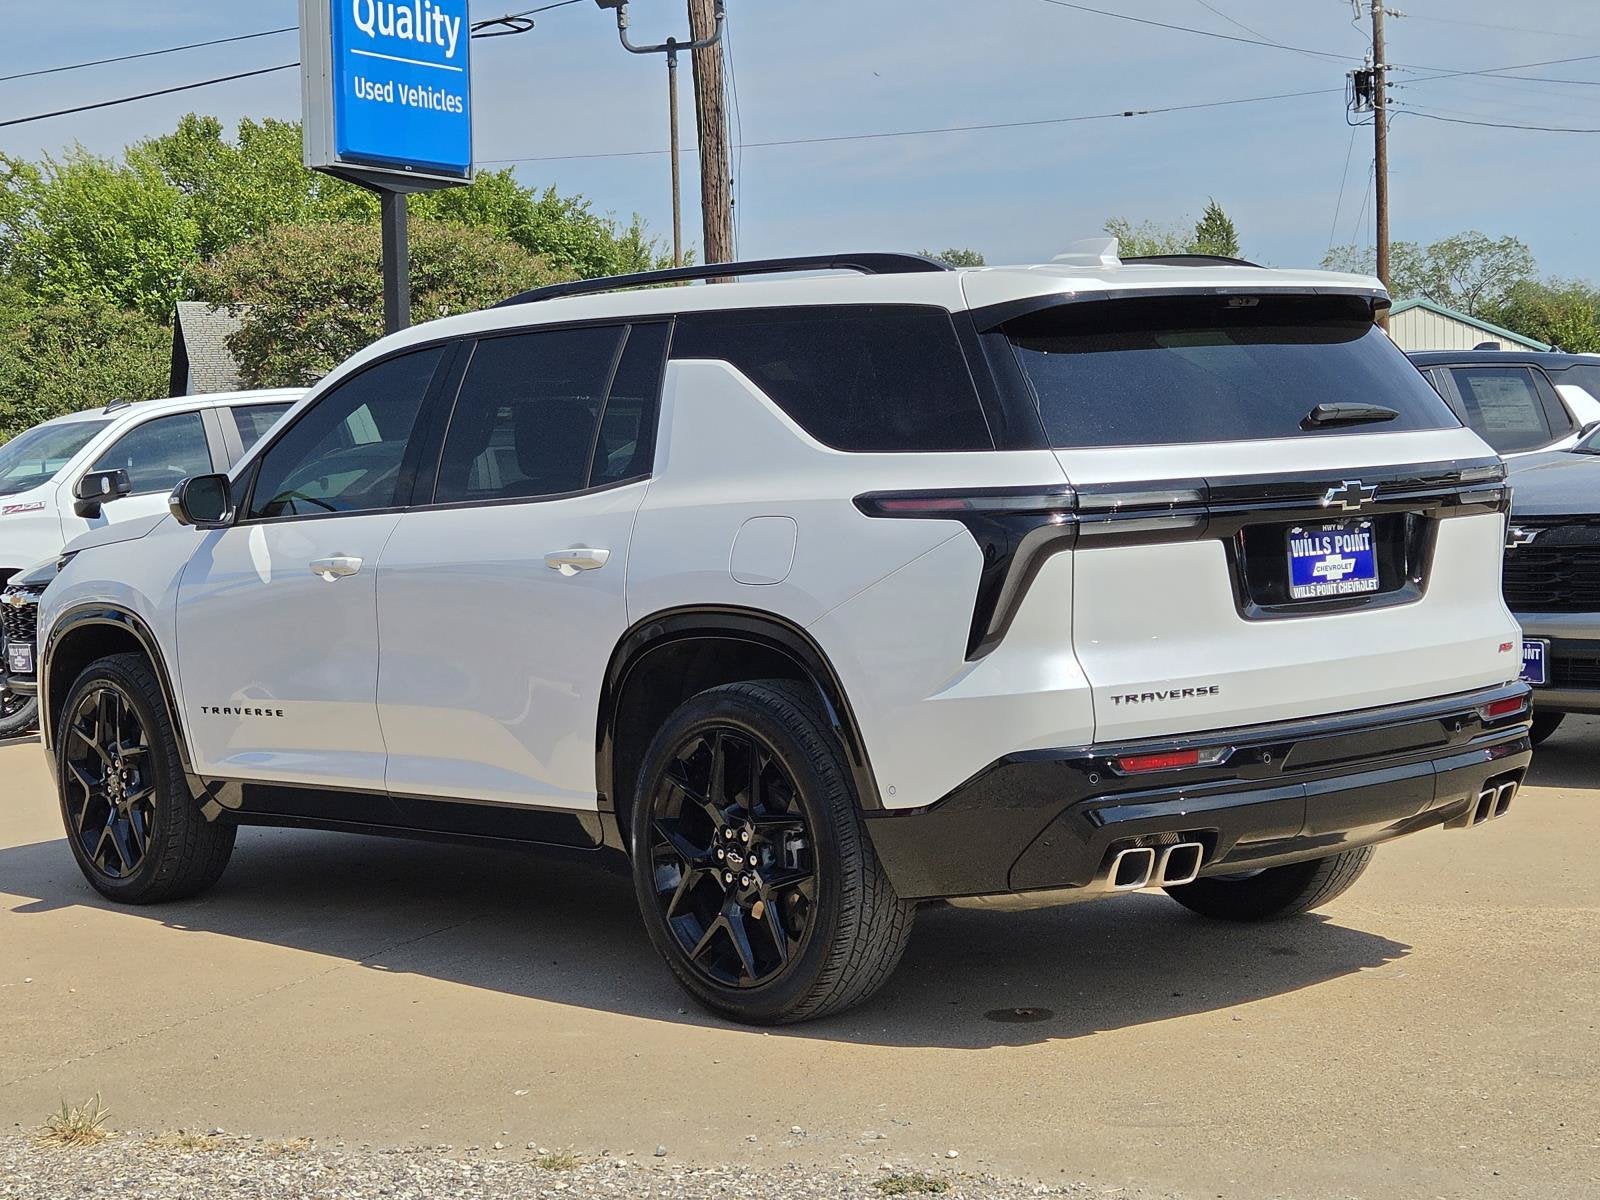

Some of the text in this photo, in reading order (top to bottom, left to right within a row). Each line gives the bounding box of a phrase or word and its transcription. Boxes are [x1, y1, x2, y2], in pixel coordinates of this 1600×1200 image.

[353, 0, 460, 58] Quality
[354, 76, 463, 113] Used Vehicles
[1291, 533, 1370, 557] WILLS POINT
[1316, 562, 1352, 572] CHEVROLET
[1293, 585, 1316, 598] WILLS
[1316, 583, 1338, 595] POINT
[1339, 580, 1377, 593] CHEVROLET
[1523, 648, 1541, 660] INT
[1111, 685, 1220, 706] TRAVERSE
[200, 706, 284, 717] TRAVERSE
